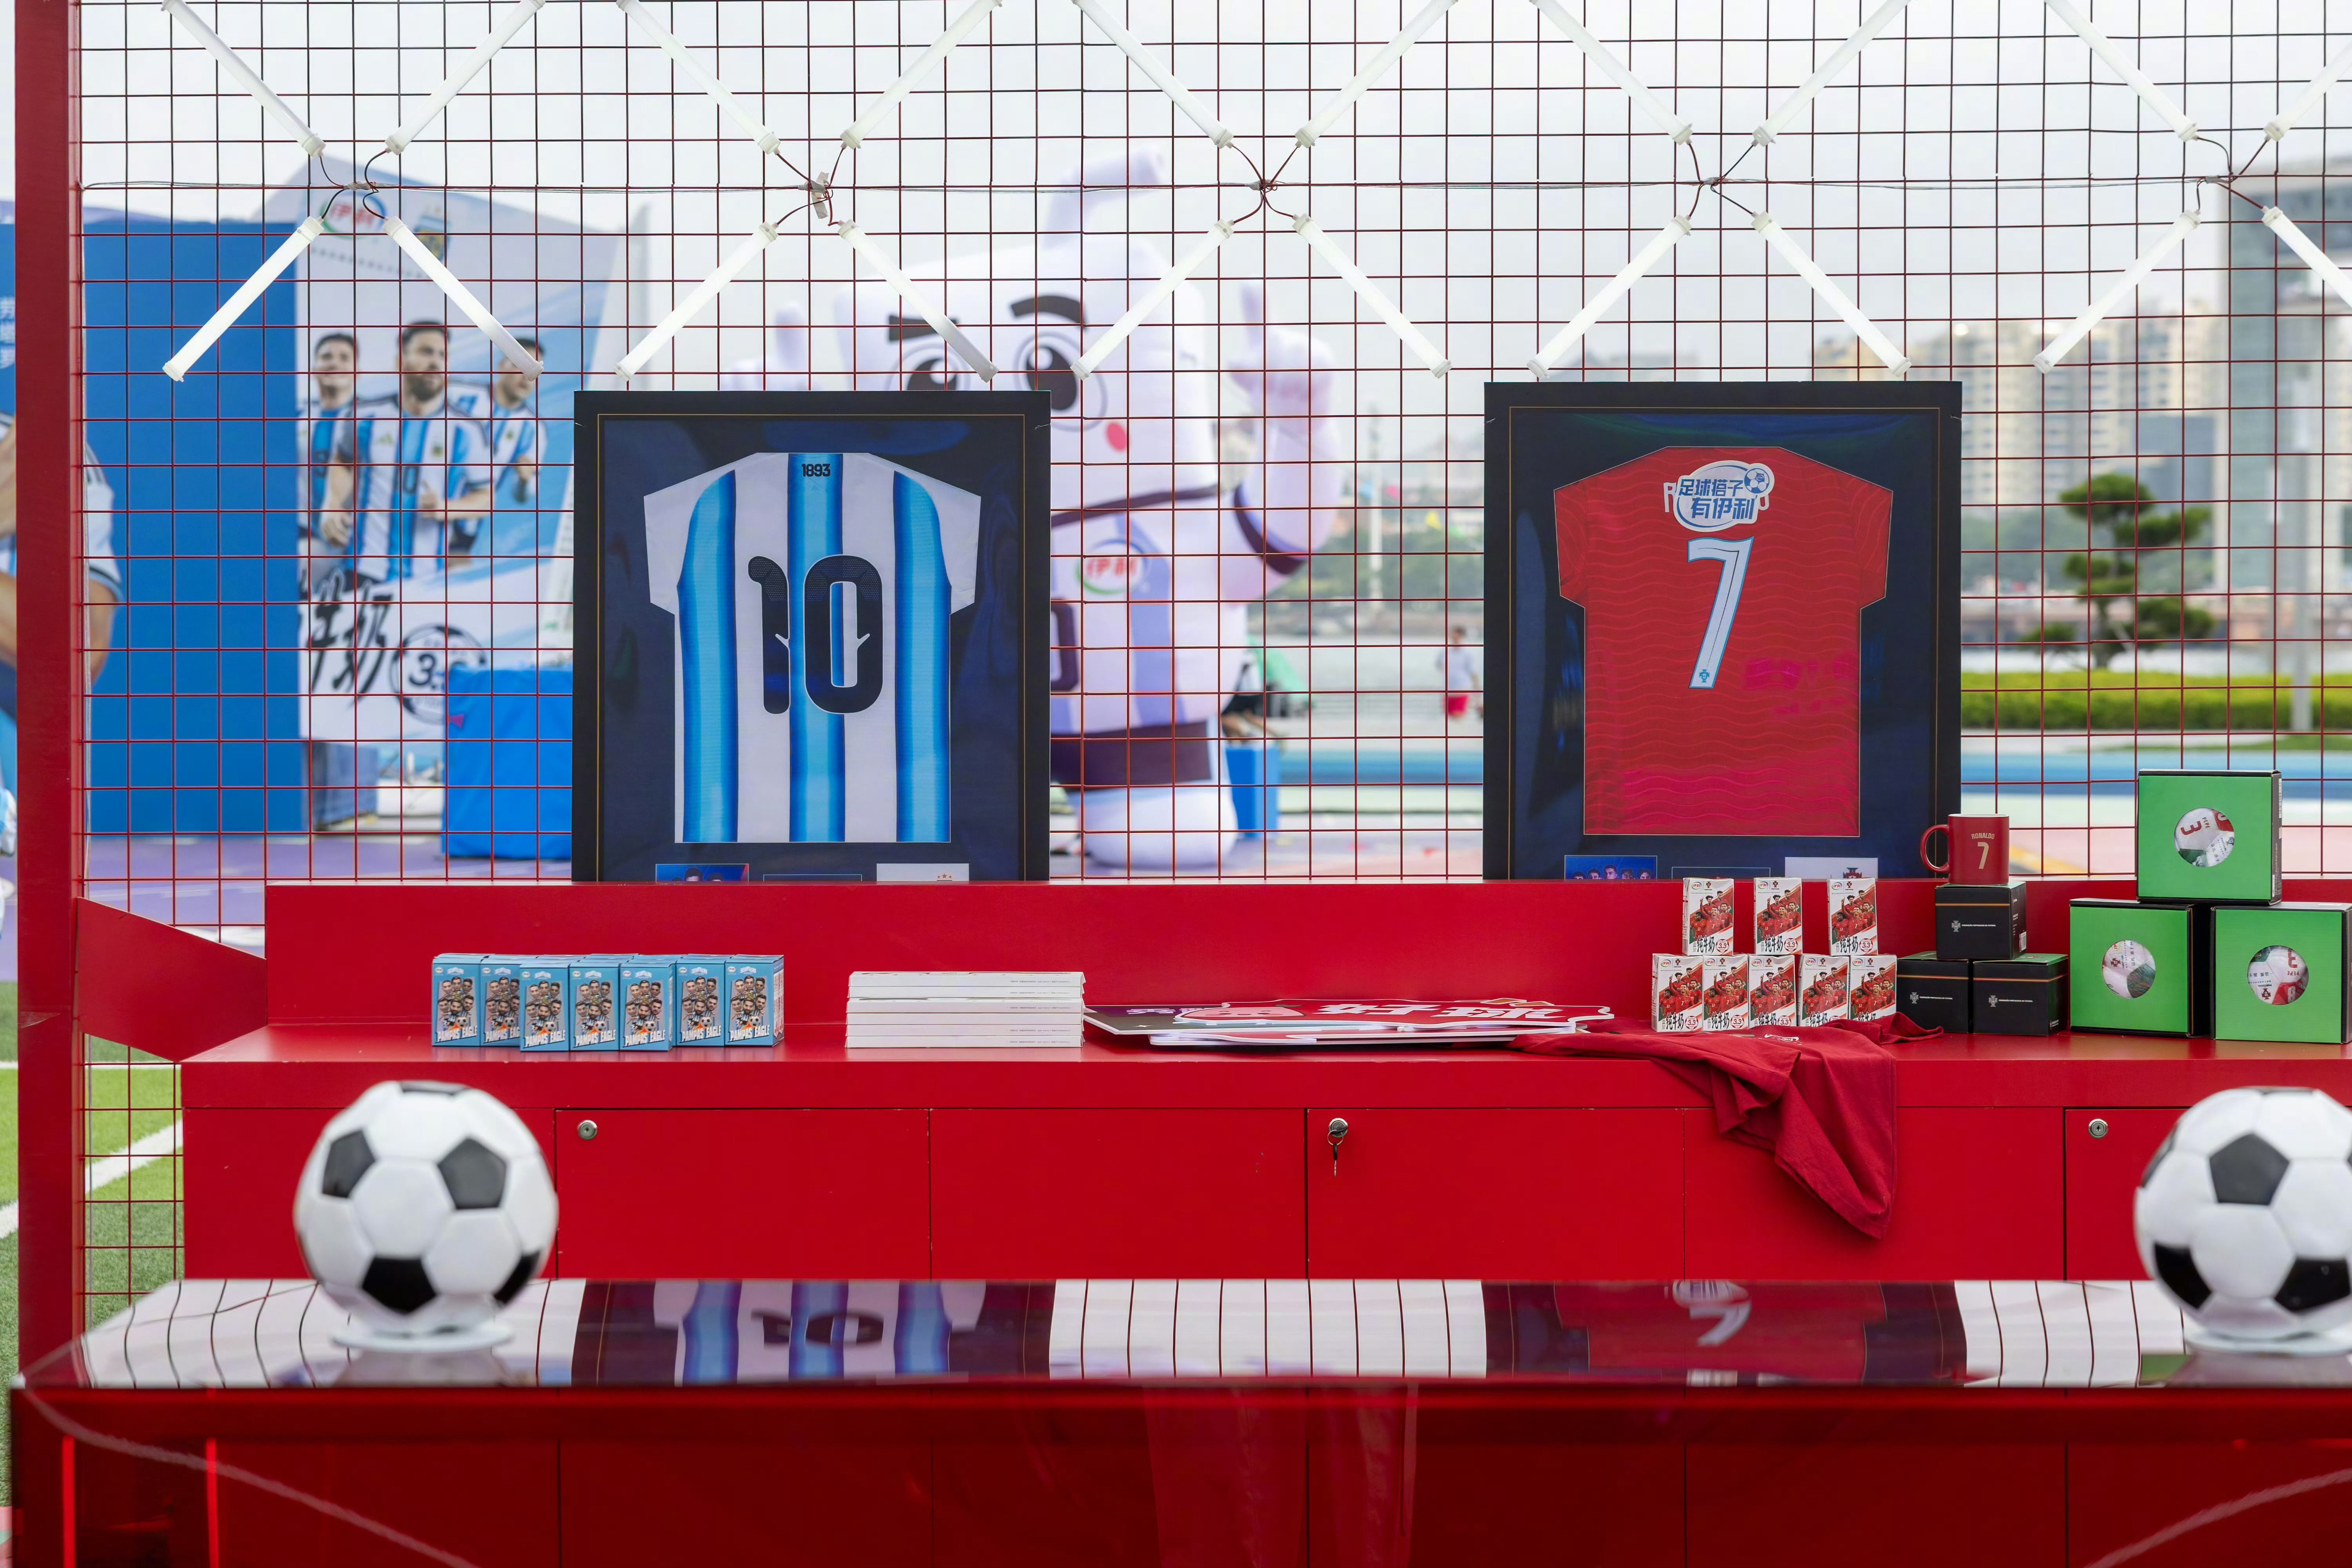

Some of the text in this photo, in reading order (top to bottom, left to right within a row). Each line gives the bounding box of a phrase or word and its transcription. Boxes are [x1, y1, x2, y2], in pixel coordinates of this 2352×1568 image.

[802, 464, 831, 477] 1893
[1679, 479, 1744, 497] 足球搭子
[1690, 497, 1755, 520] 有伊利
[1687, 536, 1754, 689] 7
[748, 555, 883, 715] 10
[2180, 820, 2202, 835] 3
[2202, 817, 2210, 829] PEPE
[1977, 842, 1989, 869] 7
[1697, 935, 1715, 953] 纯牛奶
[1765, 934, 1783, 953] 纯牛奶
[1840, 935, 1858, 953] 纯牛奶
[1312, 1004, 1566, 1019] 好球
[1711, 1011, 1730, 1029] 纯牛奶
[1666, 1012, 1684, 1031] 纯牛奶
[436, 1026, 478, 1042] PAMPAS EAGLE
[484, 1027, 520, 1042] PAMPAS EAG
[524, 1030, 566, 1047] PAMPAS EAGLE
[575, 1029, 616, 1047] PAMPAS EAGLE
[624, 1029, 666, 1047] PAMPAS EAGLE
[681, 1025, 722, 1042] PAMPAS EAGLE
[729, 1024, 770, 1042] PAMPAS EAGLE
